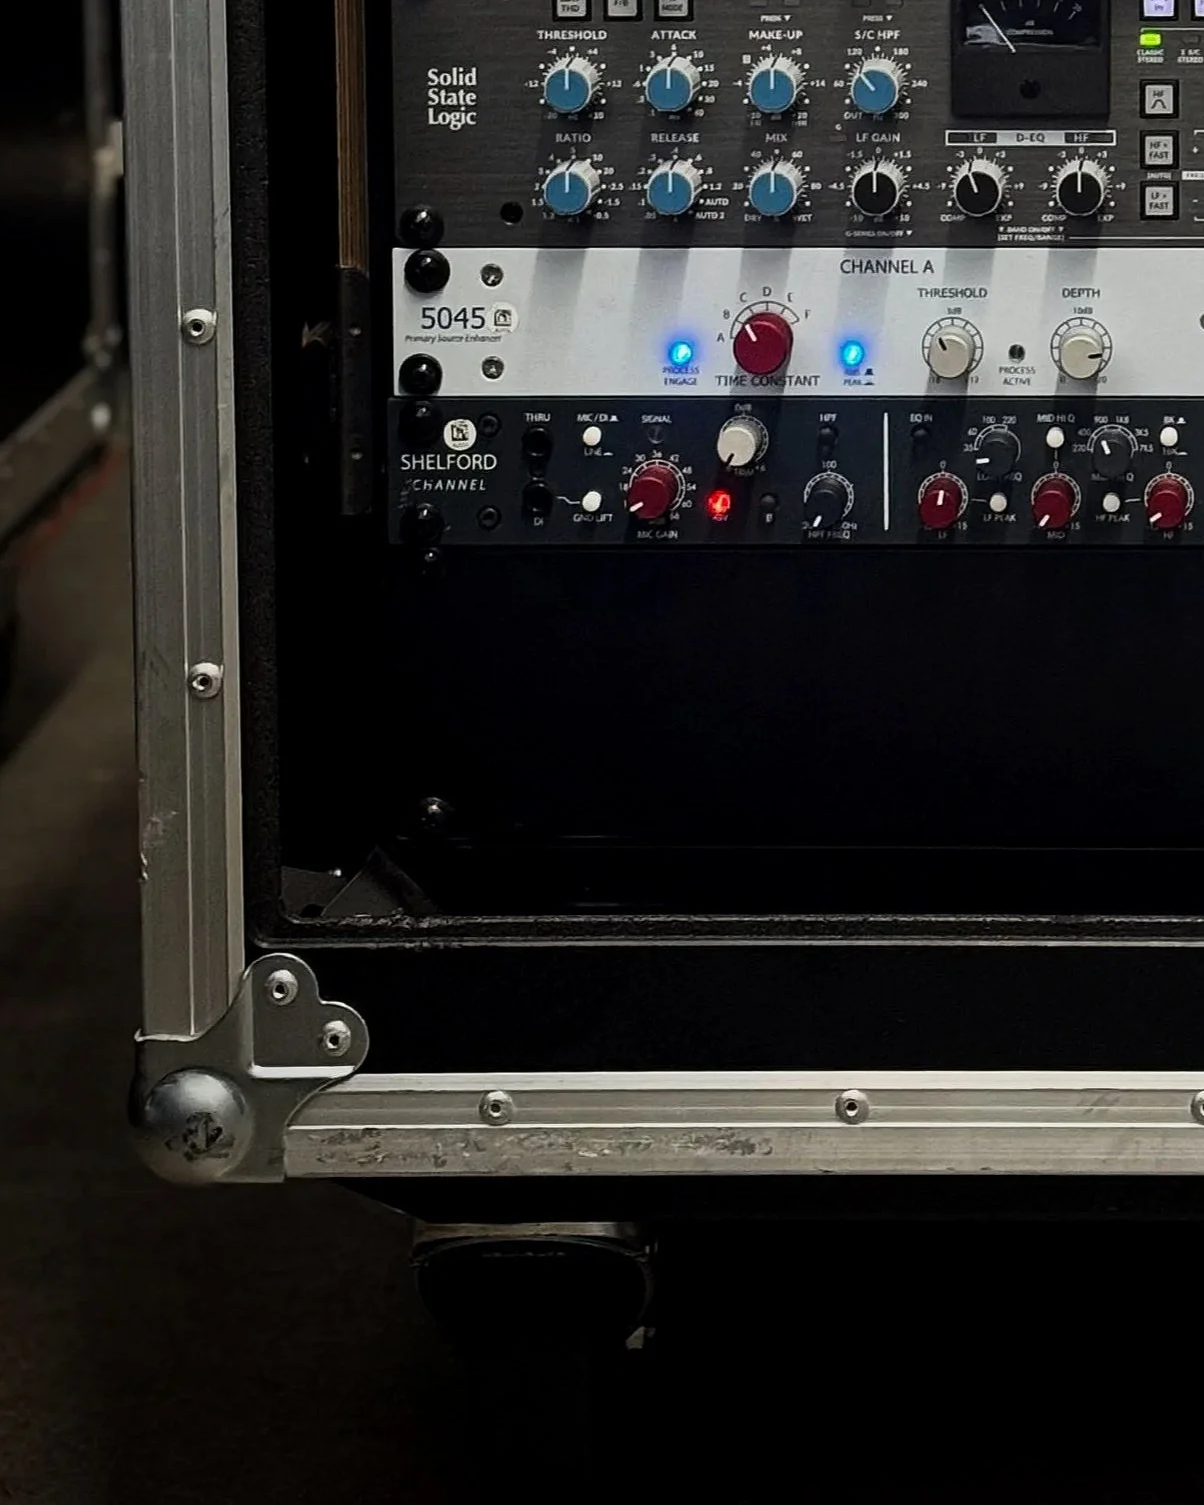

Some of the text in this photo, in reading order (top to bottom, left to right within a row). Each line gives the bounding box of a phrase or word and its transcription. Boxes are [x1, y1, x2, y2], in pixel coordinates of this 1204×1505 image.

[537, 31, 607, 40] THRESHOLD
[651, 30, 696, 40] ATTACK
[749, 30, 803, 40] MAKE-UP
[855, 30, 900, 40] S/C HPF
[428, 67, 477, 86] Solid
[428, 88, 477, 106] State
[428, 108, 477, 130] Logic
[556, 133, 591, 142] RATIO
[651, 133, 699, 142] RELEASE
[766, 133, 788, 142] MIX
[870, 133, 900, 142] GAIN
[1016, 134, 1045, 143] D-EQ
[840, 259, 934, 274] CHANNEL A
[917, 287, 987, 298] THRESHOLD
[1062, 288, 1100, 298] DEPTH
[421, 307, 486, 329] 5045
[716, 375, 819, 386] TIME CONSTANT
[526, 413, 551, 422] THRU
[641, 415, 672, 423] SIGNAL
[820, 414, 837, 422] HPF
[1037, 414, 1055, 423] MID
[401, 454, 497, 470] SHELFORD
[822, 461, 837, 469] 100
[412, 480, 486, 491] CHANNEL
[573, 514, 613, 522] GND LIFT
